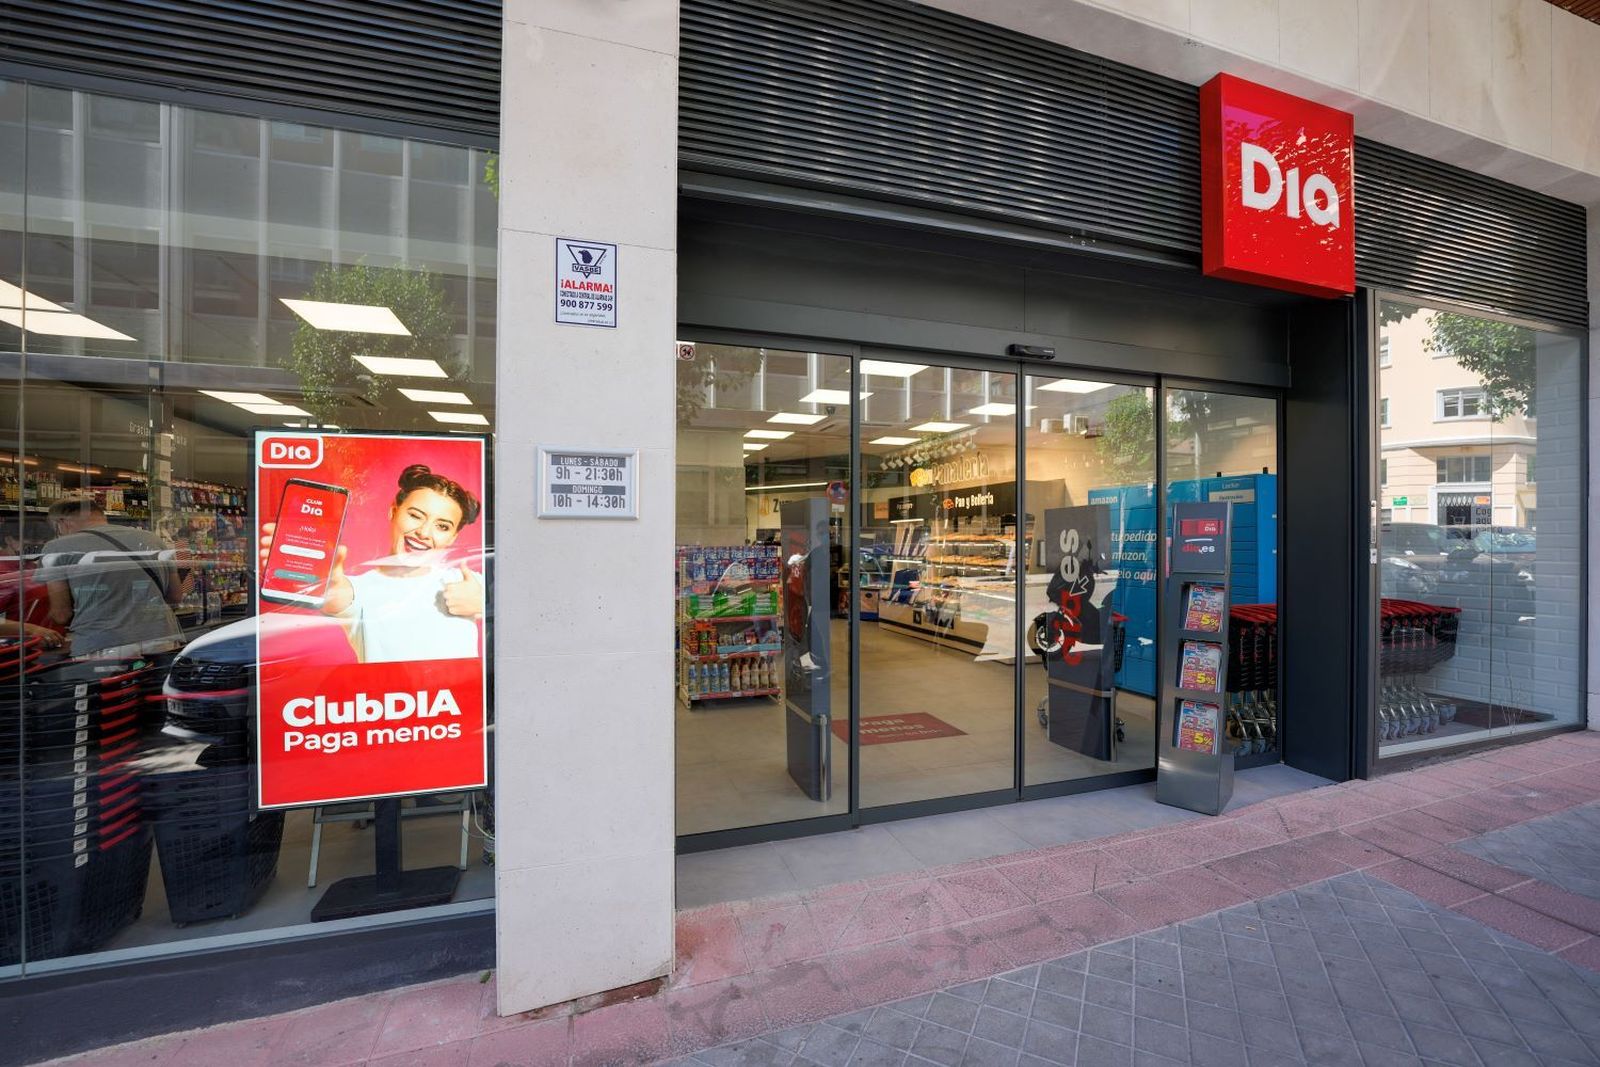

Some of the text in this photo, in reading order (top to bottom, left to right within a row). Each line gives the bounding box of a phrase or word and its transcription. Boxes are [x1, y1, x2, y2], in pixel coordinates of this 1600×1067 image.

[1241, 141, 1340, 230] Dia
[561, 279, 613, 293] ¡ALARMA!
[560, 299, 613, 311] 900 877 599
[270, 442, 311, 460] Dia
[560, 457, 582, 466] LUNES
[590, 456, 619, 467] SÁBADO
[556, 466, 570, 480] 9h
[585, 467, 623, 481] 21:30h
[572, 485, 603, 494] DOMINGO
[553, 494, 572, 508] 10h
[587, 495, 625, 509] 14:30h
[955, 497, 965, 508] Pan
[965, 498, 970, 509] y
[1090, 495, 1118, 505] amazon
[282, 689, 461, 728] ClubDIA
[284, 722, 461, 754] Paga menos
